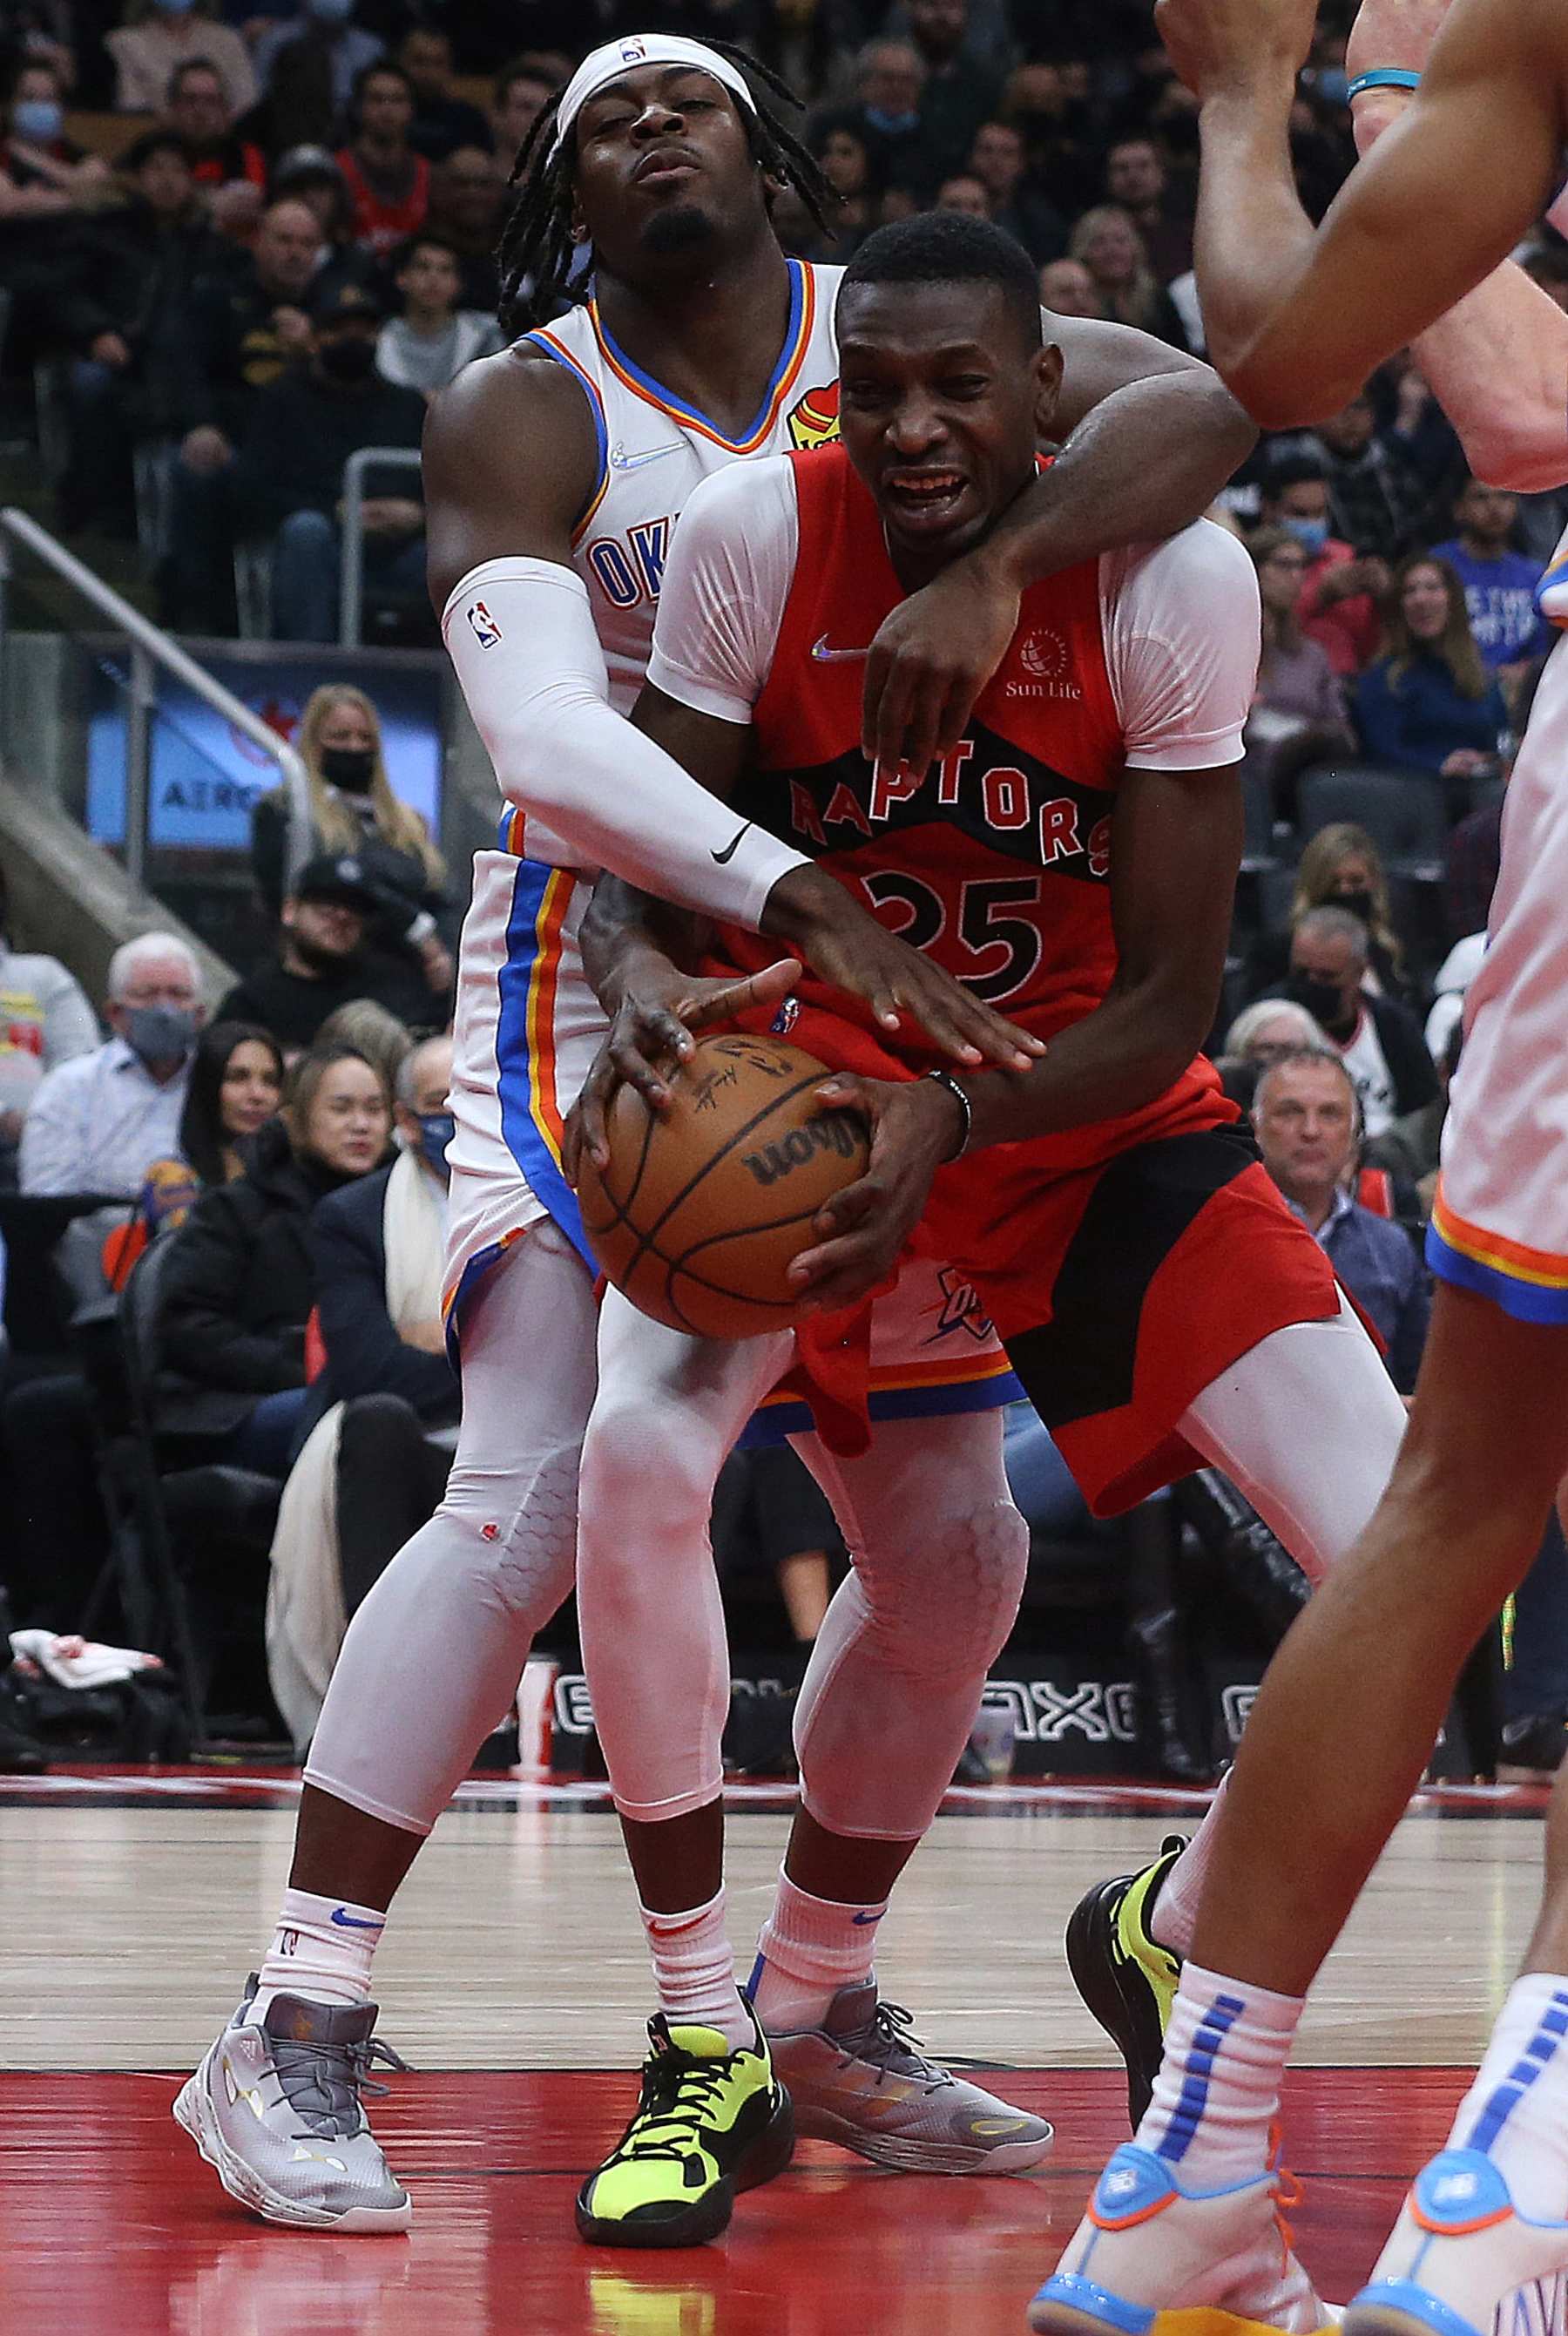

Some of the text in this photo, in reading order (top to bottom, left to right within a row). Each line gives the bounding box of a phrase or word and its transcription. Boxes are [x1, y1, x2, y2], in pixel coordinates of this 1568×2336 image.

[585, 511, 683, 612] OK
[1005, 680, 1081, 701] Sun Life
[788, 739, 1111, 877] RAPTORS
[859, 869, 1043, 1004] 25
